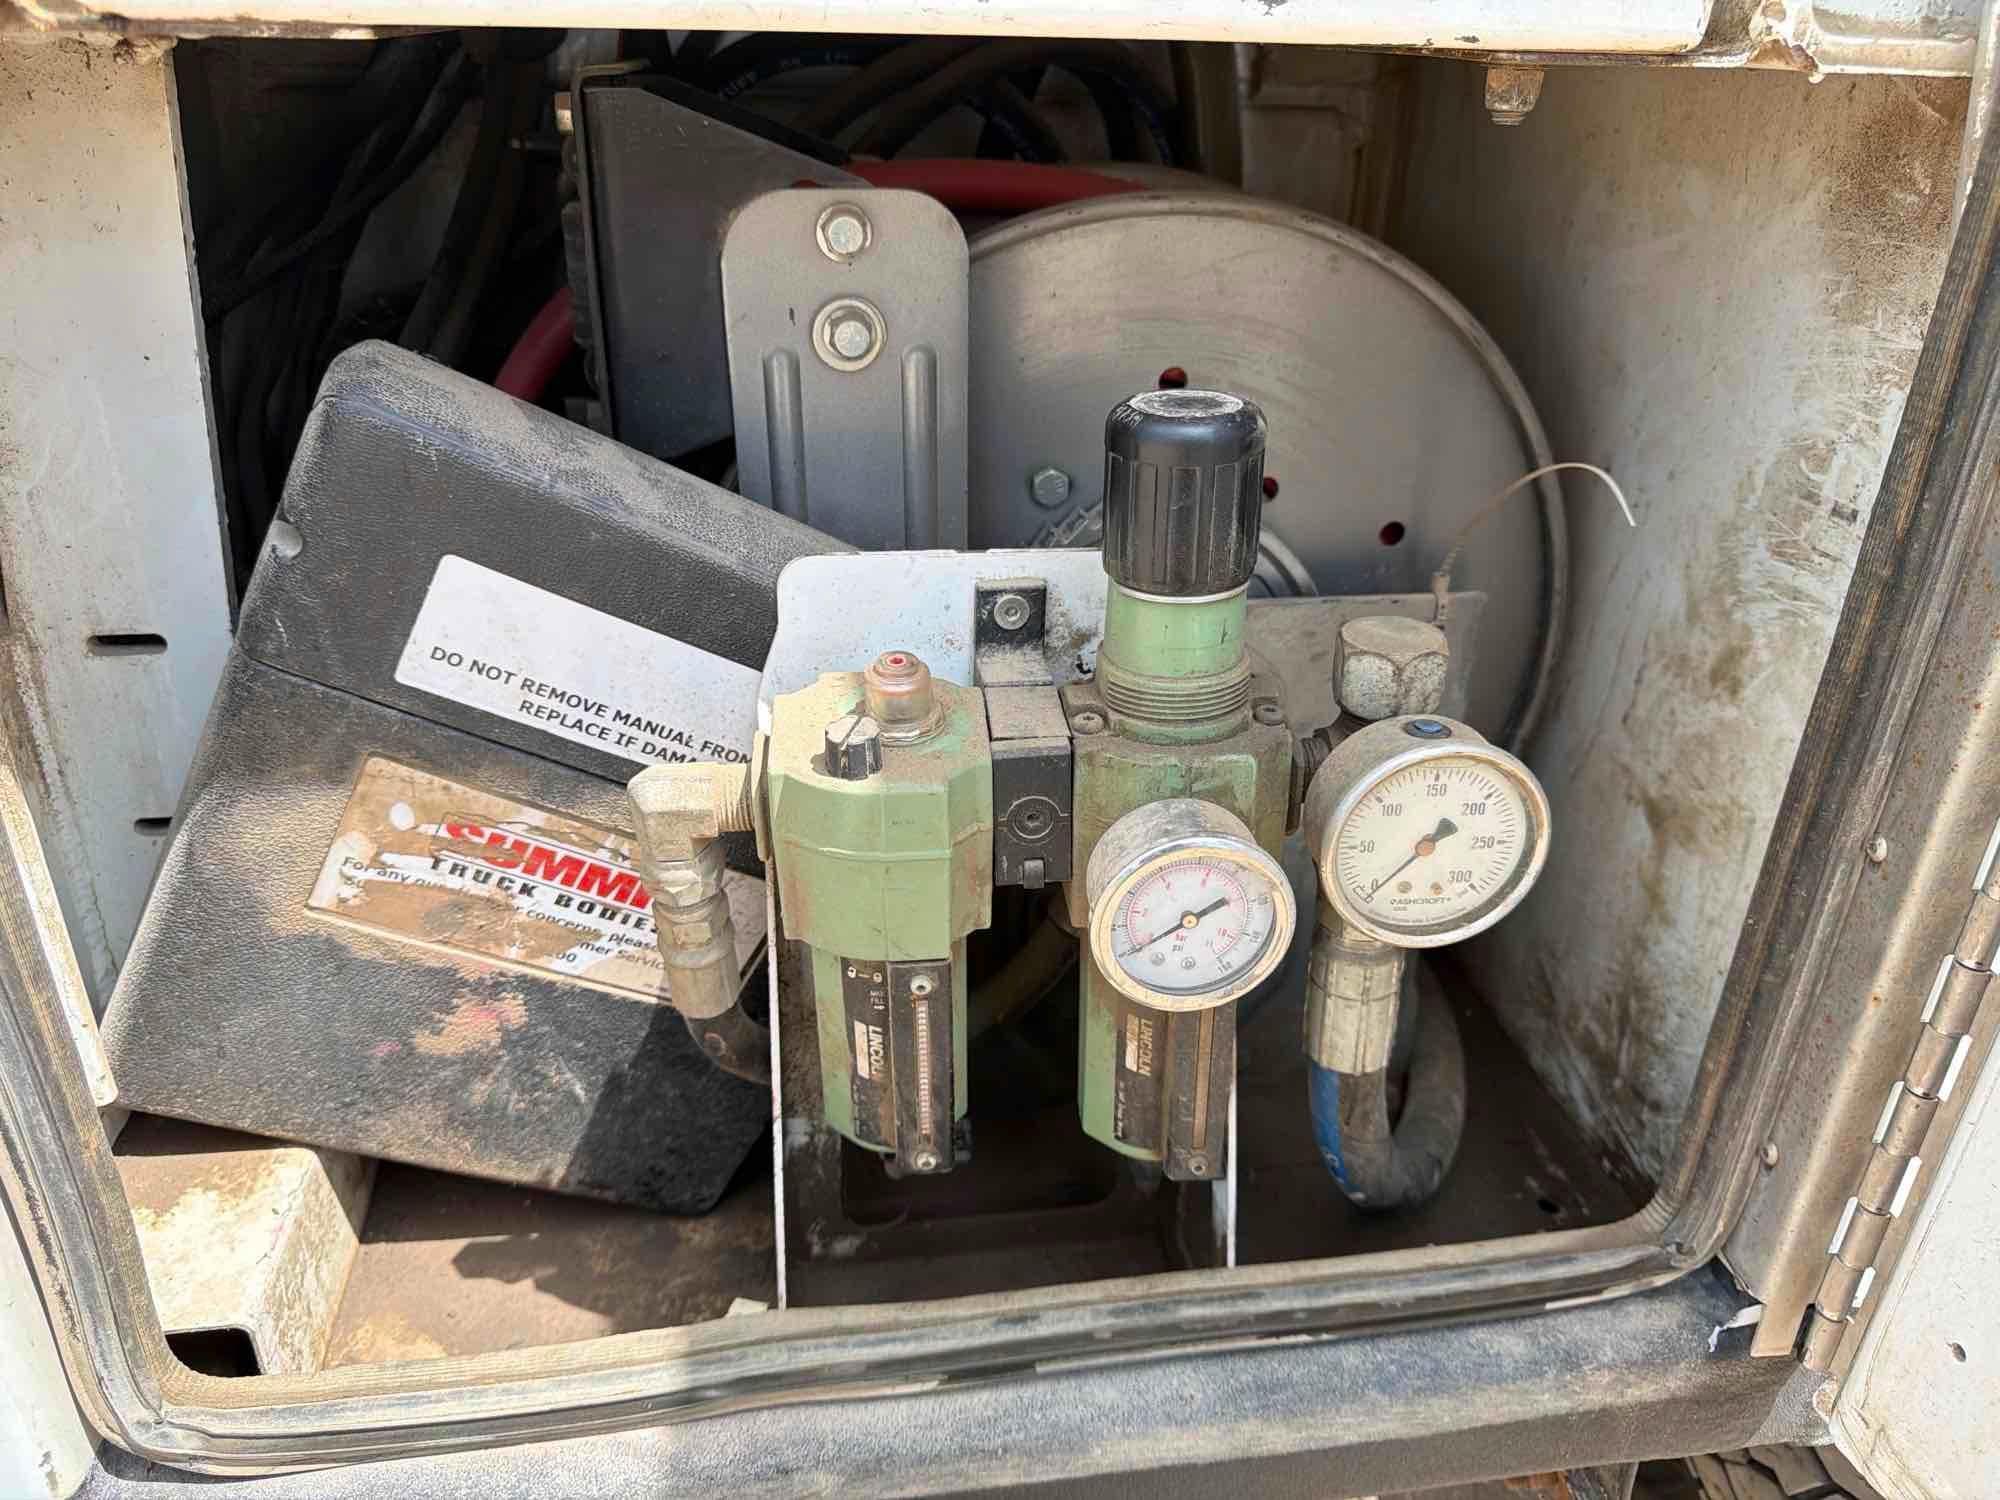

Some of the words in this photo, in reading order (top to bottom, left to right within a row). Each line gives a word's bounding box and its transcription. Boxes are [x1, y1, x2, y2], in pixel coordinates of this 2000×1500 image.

[430, 646, 463, 667] DO
[469, 659, 517, 685] NOT
[520, 677, 608, 718] REMOVE
[612, 709, 694, 749] MANUAL
[519, 700, 612, 741] REPLACE
[614, 732, 639, 749] IF
[1426, 783, 1447, 797] 150
[1381, 803, 1402, 816] 100
[1461, 802, 1486, 816] 200
[1359, 839, 1375, 853] 50
[1471, 836, 1495, 849] 250
[376, 867, 411, 884] any
[430, 855, 539, 898] TRUCK
[1448, 870, 1472, 882] 300
